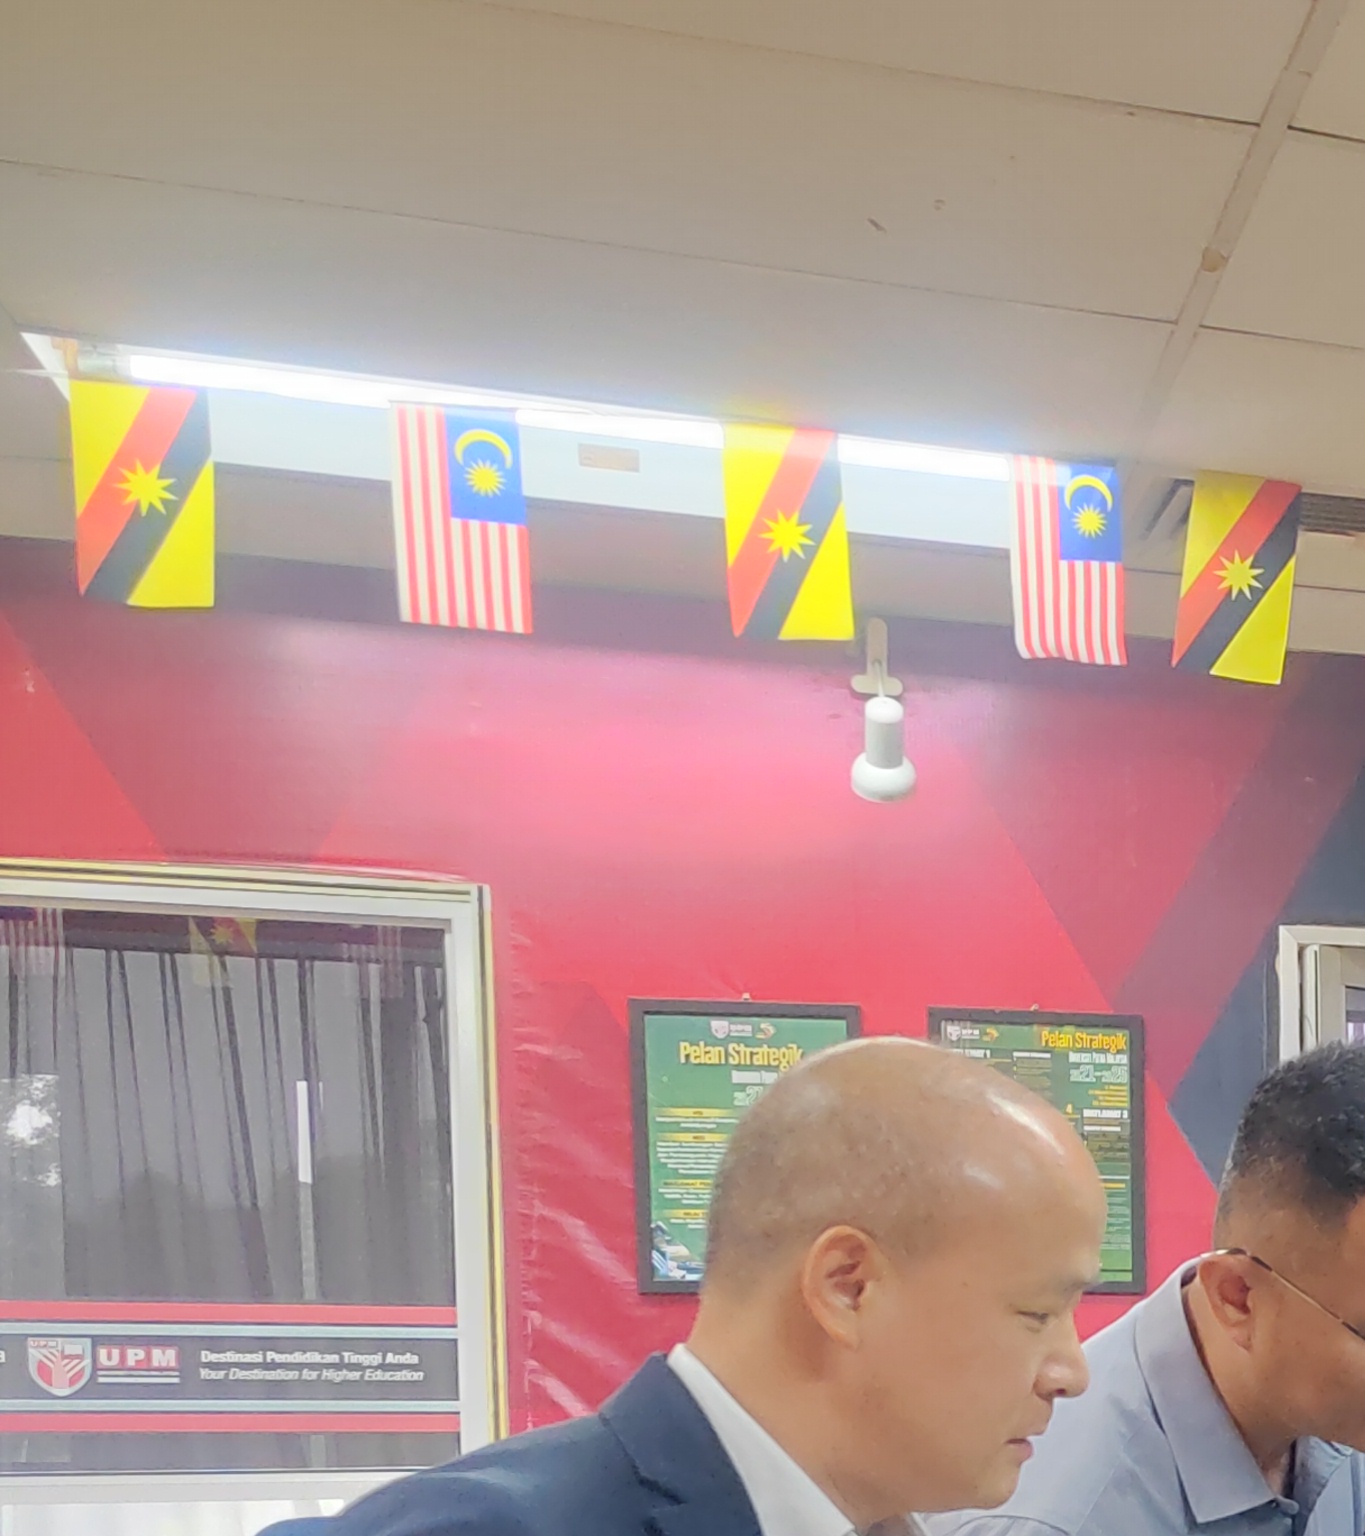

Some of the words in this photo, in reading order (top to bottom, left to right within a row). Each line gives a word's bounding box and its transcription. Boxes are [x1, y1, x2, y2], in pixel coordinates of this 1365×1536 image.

[1041, 1030, 1073, 1048] Pelan
[1074, 1031, 1127, 1053] Strategik
[679, 1041, 726, 1065] Pelan
[728, 1042, 804, 1072] Strategik
[98, 1348, 177, 1367] UPM
[201, 1350, 263, 1363] Destinasi
[266, 1350, 340, 1363] Pendidikan
[342, 1351, 383, 1366] Tinggi
[385, 1352, 419, 1364] Anda
[199, 1367, 228, 1380] Your
[228, 1367, 299, 1380] Destination
[301, 1368, 318, 1380] for
[320, 1368, 362, 1383] Higher
[364, 1369, 424, 1381] Education
